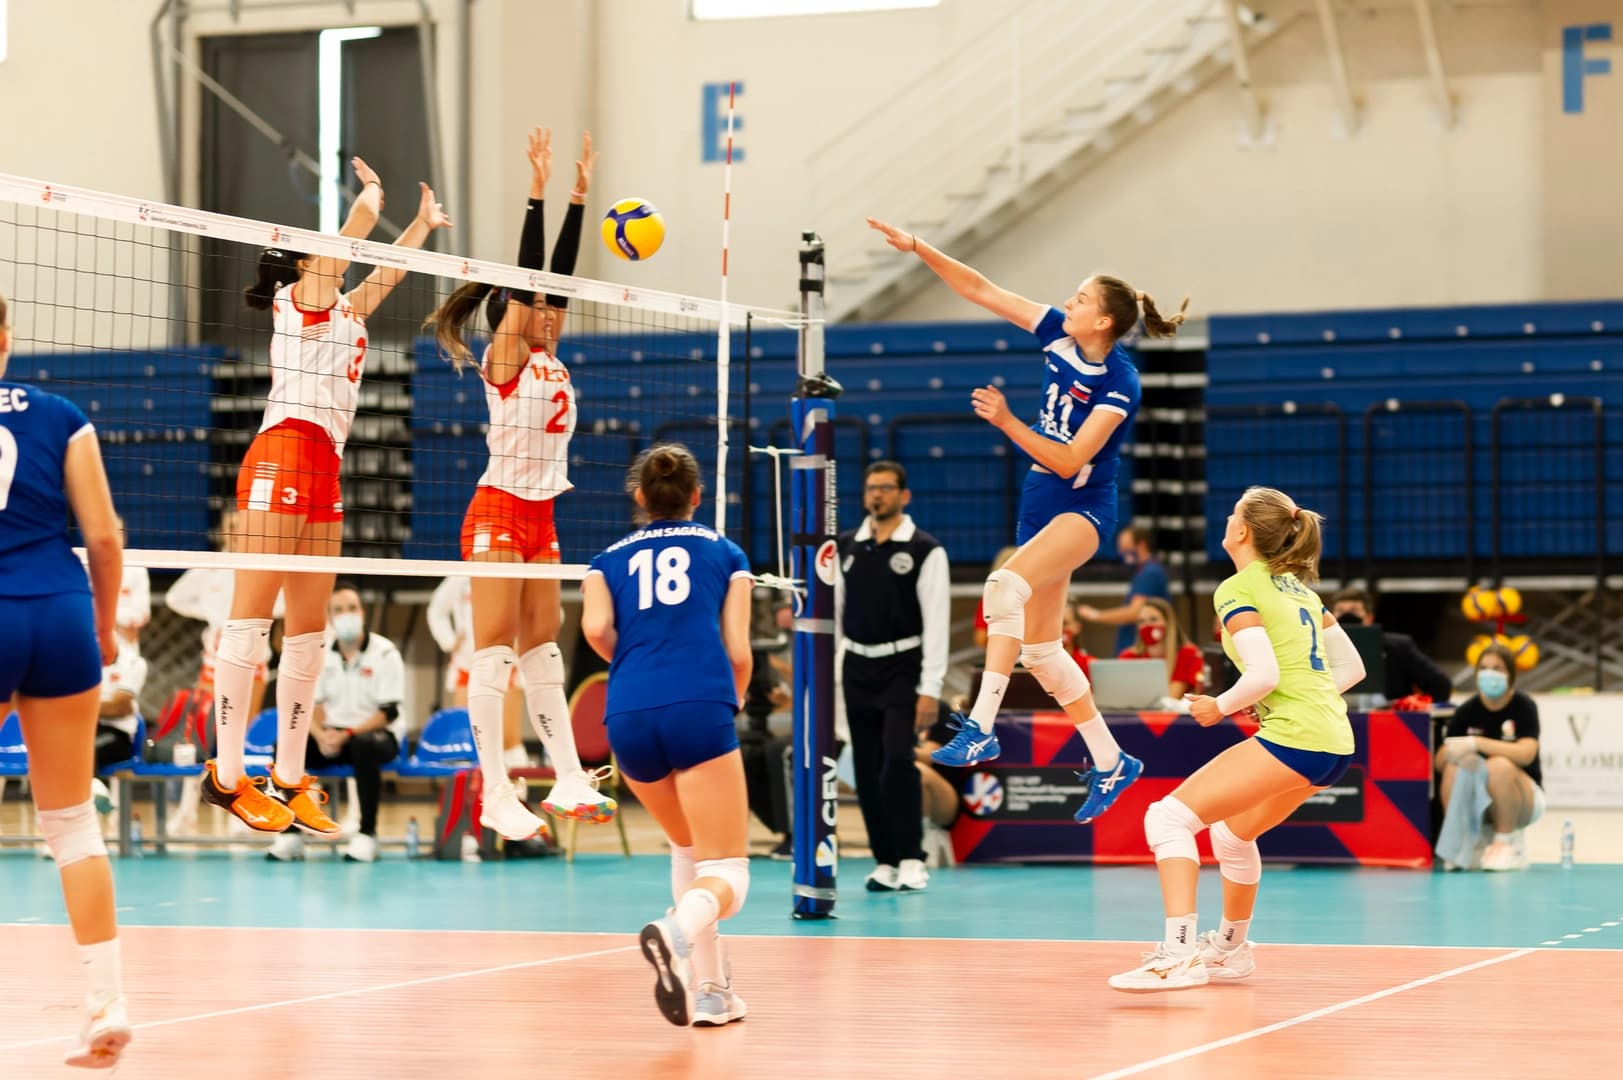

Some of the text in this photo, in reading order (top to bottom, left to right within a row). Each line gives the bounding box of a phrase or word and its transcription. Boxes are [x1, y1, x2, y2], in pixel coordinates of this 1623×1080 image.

[1562, 24, 1612, 113] F
[702, 82, 744, 163] E
[545, 390, 569, 433] 2
[281, 486, 299, 505] 3
[628, 546, 691, 610] 18
[1299, 607, 1326, 671] 2
[822, 755, 838, 827] CEV
